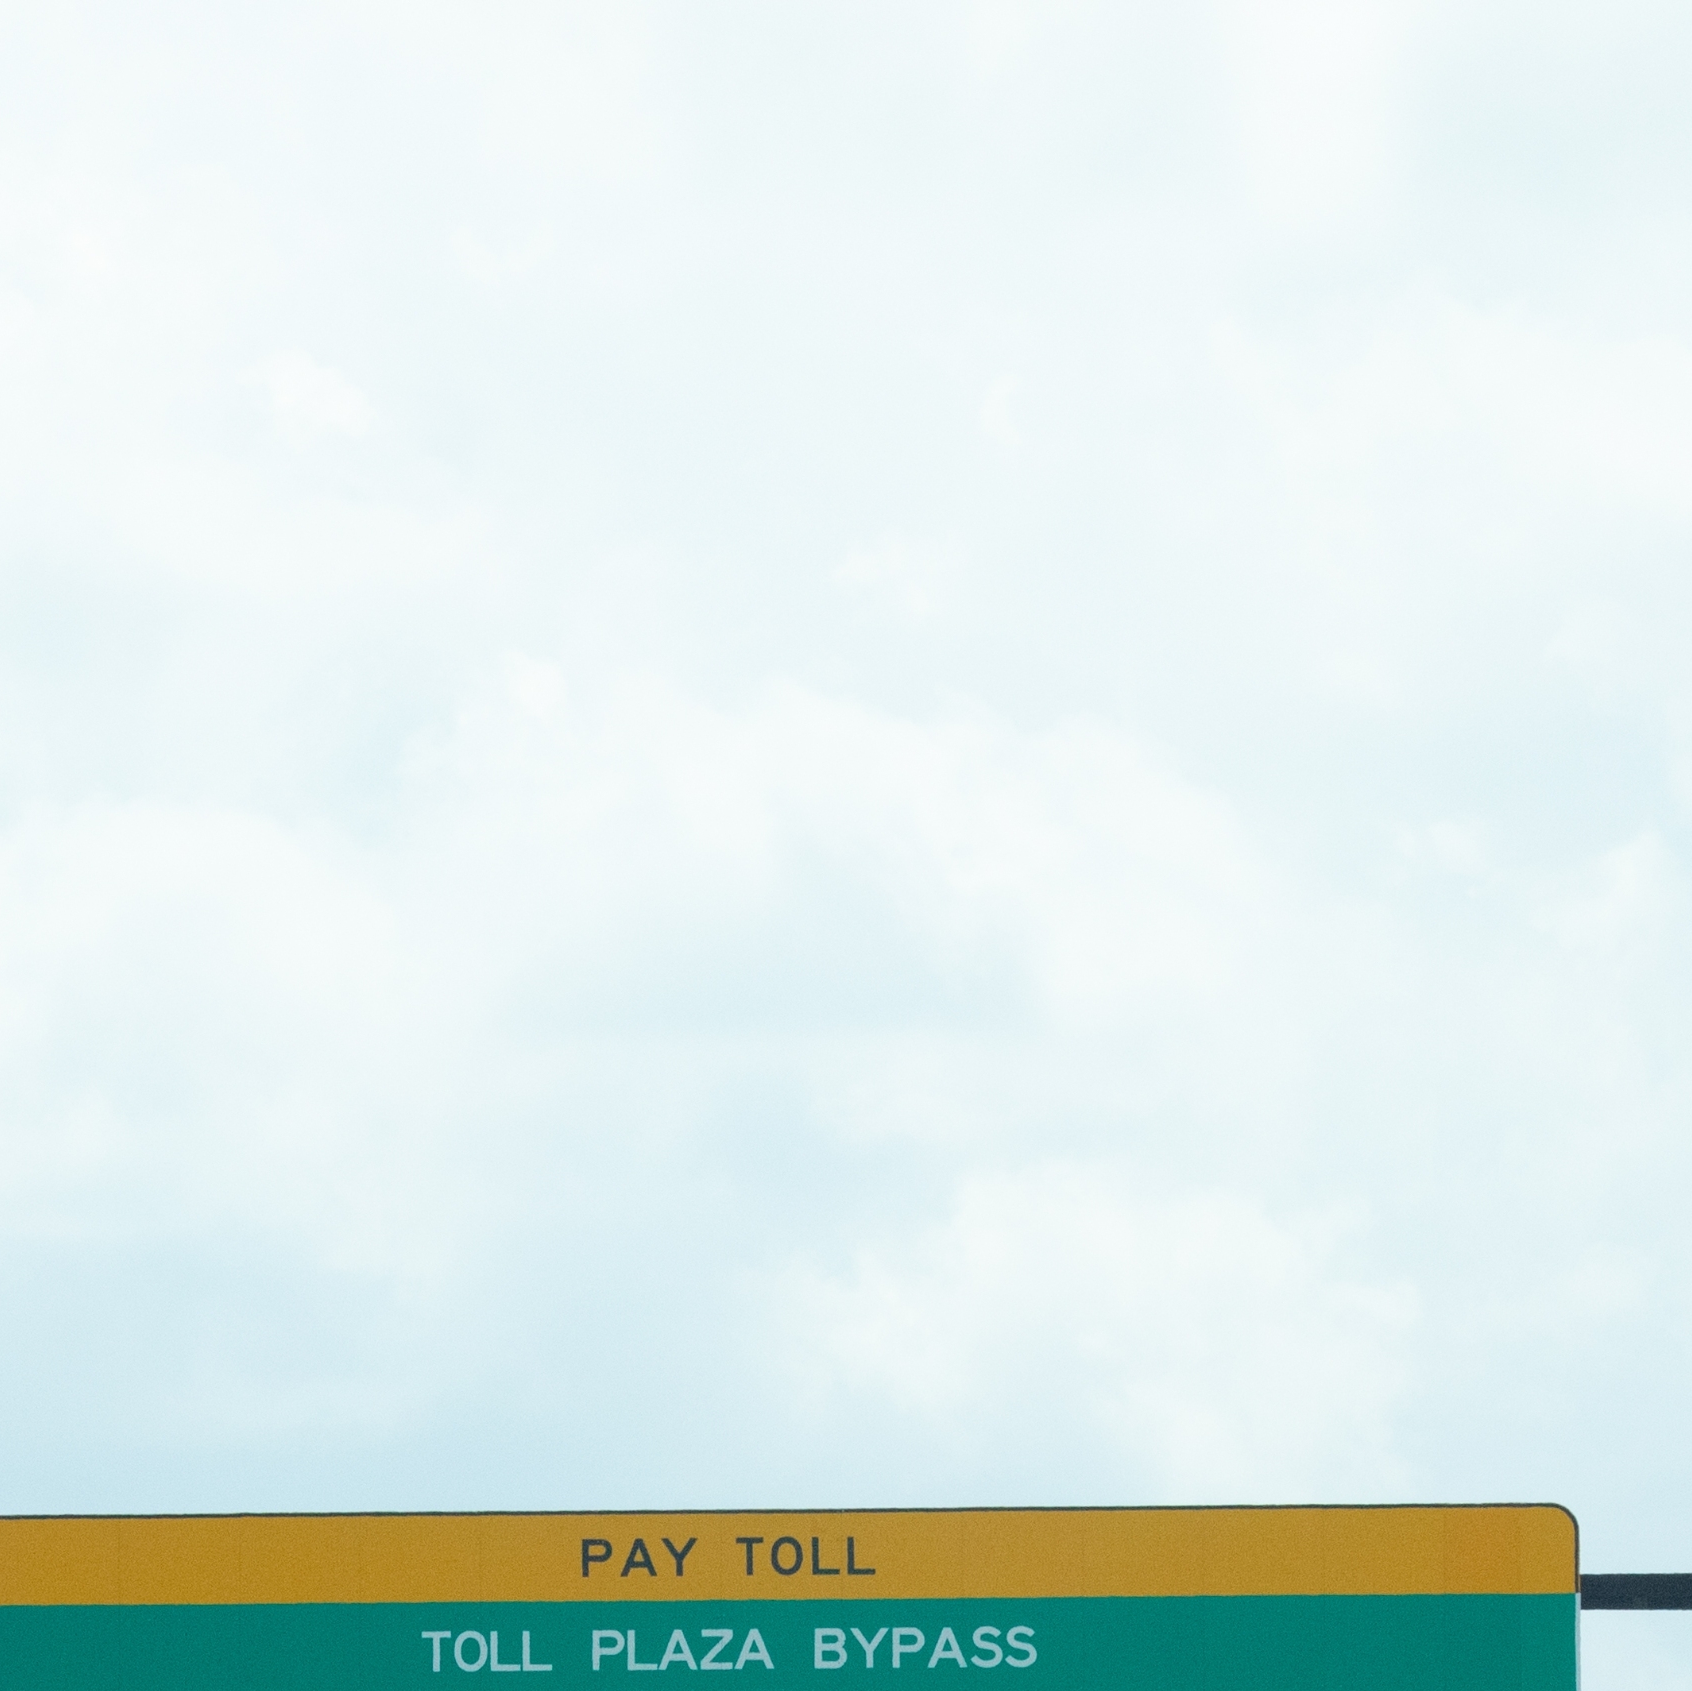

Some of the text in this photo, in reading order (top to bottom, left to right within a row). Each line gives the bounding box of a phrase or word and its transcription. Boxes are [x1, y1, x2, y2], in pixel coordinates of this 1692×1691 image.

[580, 1536, 876, 1579] PAY TOLL
[421, 1625, 1039, 1673] TOLL PLAZA BYPASS
